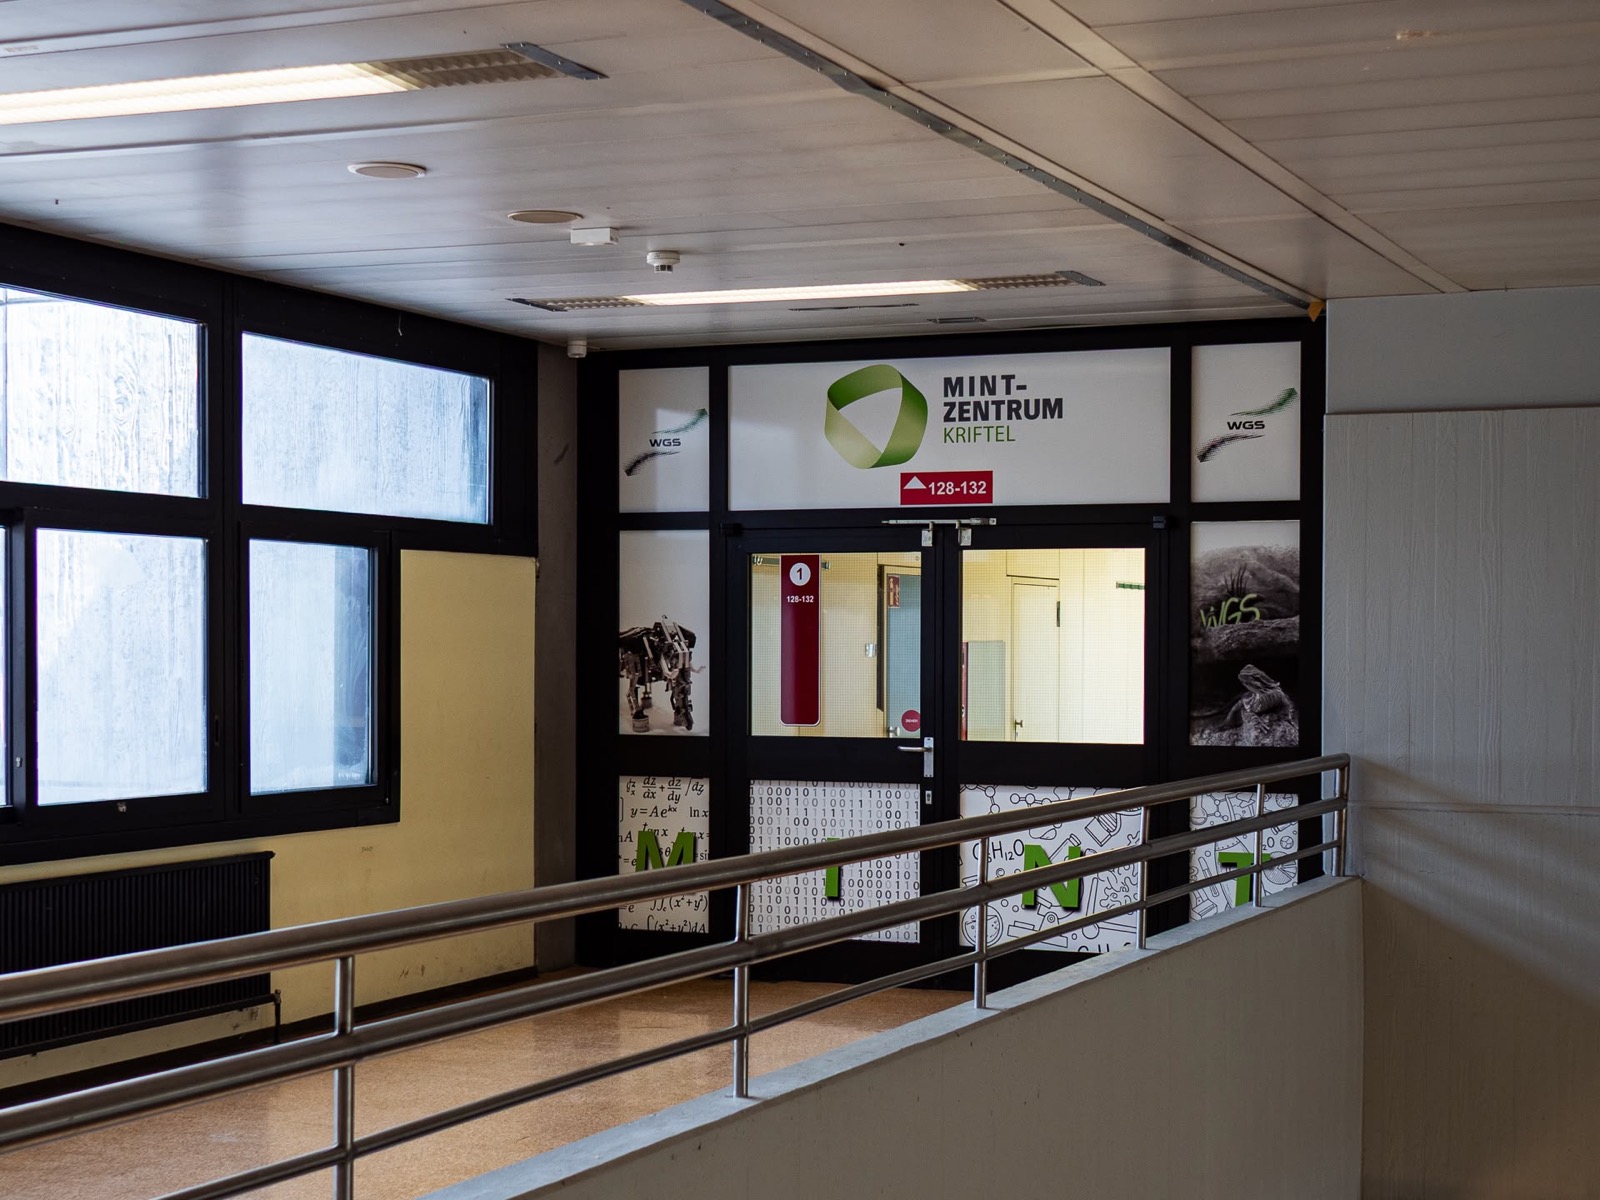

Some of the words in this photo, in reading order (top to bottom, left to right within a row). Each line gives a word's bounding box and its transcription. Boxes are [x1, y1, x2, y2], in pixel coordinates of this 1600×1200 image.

[943, 374, 1027, 398] MINT-
[943, 398, 1063, 423] ZENTRUM
[1226, 420, 1266, 430] WGS
[943, 425, 1016, 443] KRIFTEL
[649, 438, 682, 447] WGS
[928, 480, 987, 495] 128-132
[796, 567, 803, 580] 1
[786, 595, 815, 603] 128-132
[635, 831, 695, 872] M
[1022, 844, 1081, 908] N
[1218, 852, 1272, 907] T
